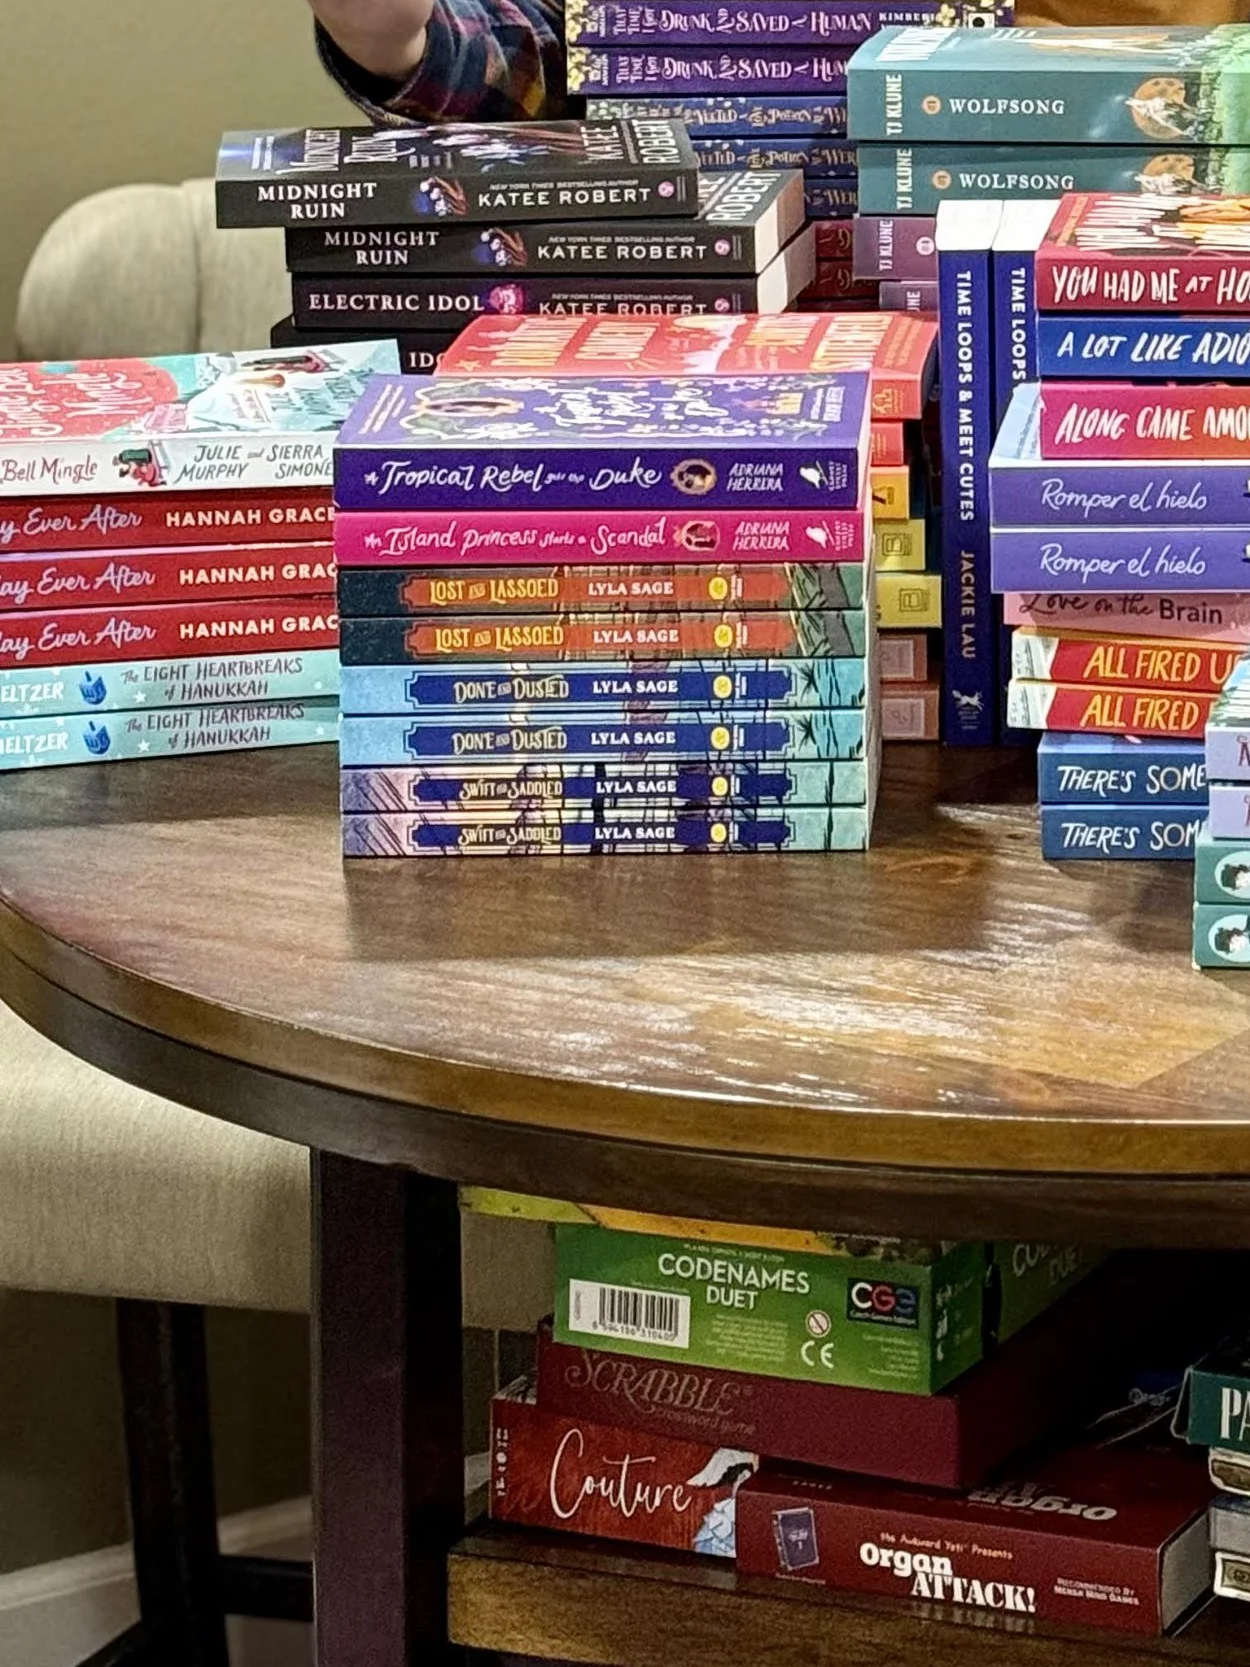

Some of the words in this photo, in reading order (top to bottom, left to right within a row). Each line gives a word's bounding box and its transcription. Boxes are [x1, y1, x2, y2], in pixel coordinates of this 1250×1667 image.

[658, 10, 712, 32] DRUNK
[736, 8, 790, 32] SAVED
[811, 8, 872, 36] HUMAN
[950, 99, 1065, 114] WOLFSONG
[258, 183, 377, 201] MIDNIGHT
[959, 174, 1074, 191] WOLFSONG
[291, 203, 345, 219] RUIN
[479, 192, 550, 207] KATEE
[559, 188, 651, 204] ROBERT
[325, 232, 439, 246] MIDNIGHT
[538, 246, 607, 259] KATEE
[617, 245, 707, 259] ROBERT
[356, 251, 408, 265] RUIN
[957, 271, 971, 316] TIME
[1052, 266, 1098, 304] YOU
[1103, 270, 1145, 302] HAD
[1151, 268, 1180, 303] ME
[1186, 276, 1213, 292] AT
[309, 294, 420, 311] ELECTRIC
[429, 296, 485, 311] IDOL
[957, 322, 972, 386] LOOPS
[1057, 332, 1073, 358] A
[1082, 334, 1128, 358] LOT
[1131, 333, 1192, 361] LIKE
[959, 407, 974, 456] MEET
[1054, 403, 1129, 444] ALONG
[1136, 405, 1195, 442] CAME
[2, 455, 36, 480] Bell
[40, 454, 97, 484] Mingle
[195, 445, 241, 463] JULIE
[266, 444, 323, 460] SIERRA
[178, 462, 250, 481] MURPHY
[379, 460, 474, 497] Tropical
[481, 464, 543, 495] Rebel
[590, 457, 661, 489] Duke
[729, 463, 783, 476] ADRIANA
[727, 477, 783, 491] HERRERA
[960, 459, 975, 521] CUTES
[1042, 479, 1126, 519] Romper
[1154, 480, 1207, 511] hielo
[24, 507, 76, 537] Ever
[80, 505, 141, 530] After
[167, 509, 261, 527] HANNAH
[269, 506, 335, 524] GRACE
[461, 529, 537, 556] Princess
[590, 516, 666, 555] Scandal
[430, 581, 465, 605] LOST
[490, 579, 559, 602] LASSOED
[588, 583, 627, 595] LYLA
[632, 582, 673, 595] SAGE
[960, 550, 975, 617] JACKIE
[1159, 598, 1223, 624] Brain
[961, 622, 976, 659] LAU
[144, 664, 190, 682] EIGHT
[198, 657, 303, 678] HEARTBREAKS
[1083, 646, 1127, 679] ALL
[1136, 650, 1201, 684] FIRED
[181, 682, 268, 700] HANUKKAH
[592, 681, 632, 694] LYLA
[636, 680, 678, 693] SAGE
[596, 781, 632, 793] LYLA
[637, 779, 677, 793] SAGE
[658, 1253, 810, 1294] CODENAMES
[706, 1285, 759, 1311] DUET
[565, 1348, 738, 1417] SCRABBLE
[550, 1428, 692, 1518] Couture
[860, 1542, 952, 1576] Organ
[912, 1572, 1036, 1614] ATTACK!
